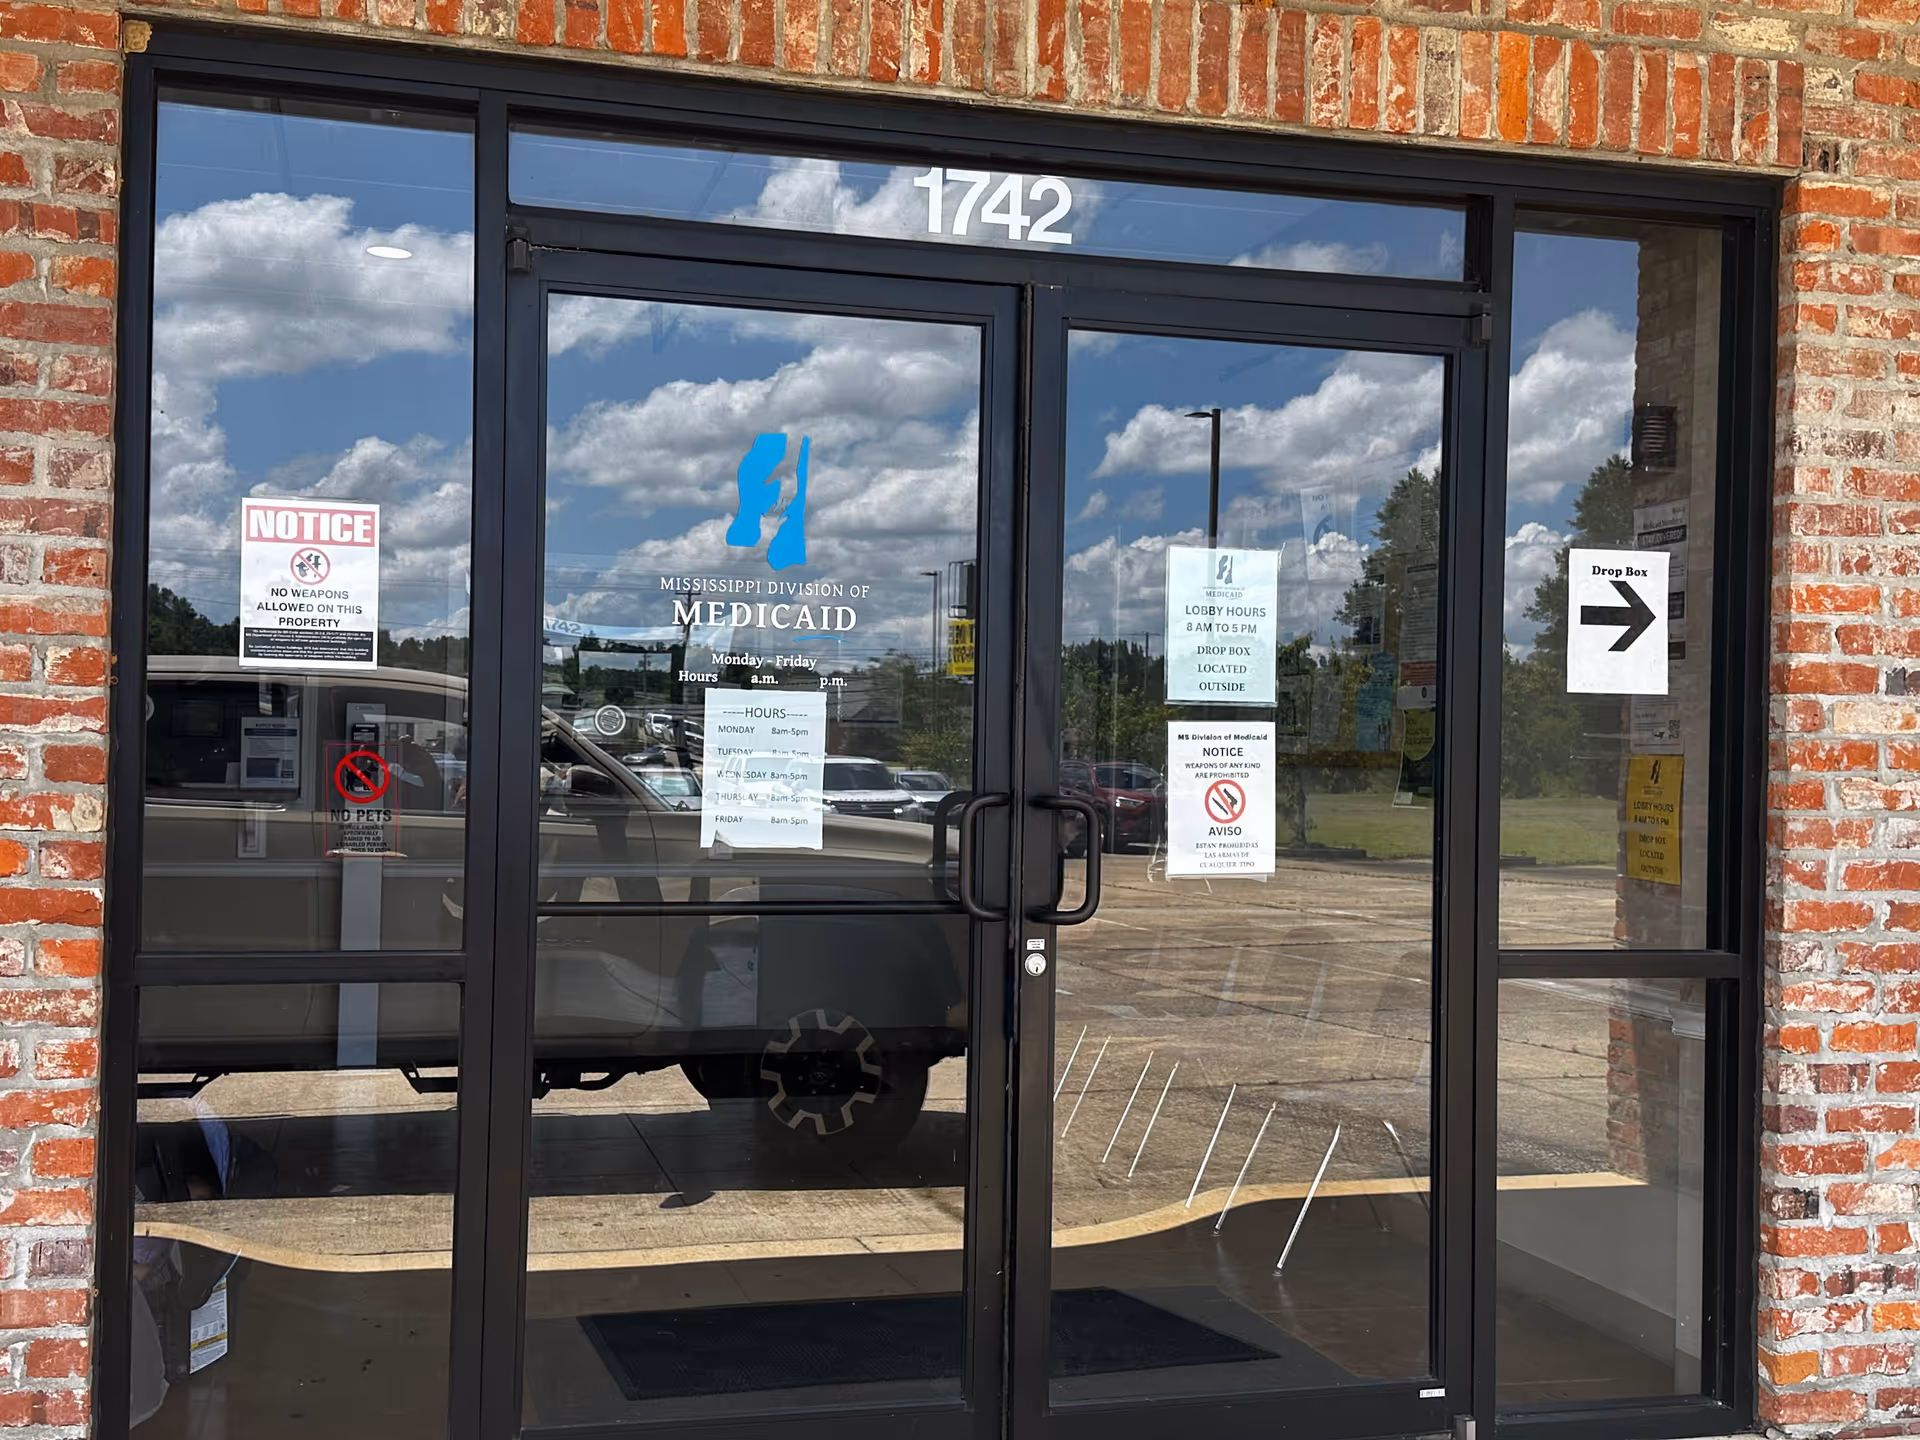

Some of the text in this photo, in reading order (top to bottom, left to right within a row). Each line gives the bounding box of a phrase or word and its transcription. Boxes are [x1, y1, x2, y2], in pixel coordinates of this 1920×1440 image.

[913, 166, 1073, 245] 1742
[249, 508, 372, 543] NOTICE
[1592, 565, 1648, 578] Drop Box
[660, 576, 870, 598] MISSISSIPPI DIVISION OF
[271, 588, 349, 599] NO WEAPONS
[1205, 590, 1243, 599] MEDICAID
[257, 602, 362, 614] ALLOWED ON THIS
[1186, 605, 1266, 618] LOBBY HOURS
[671, 600, 857, 631] MEDICAID
[279, 617, 340, 628] PROPERTY
[1186, 622, 1257, 634] 8 AM TO 5 PM
[1197, 645, 1251, 656] DROP BOX
[711, 653, 764, 669] Monday
[775, 655, 817, 671] Friday
[1197, 664, 1247, 674] LOCATED
[678, 671, 848, 689] Hours a.m. p.m.
[1199, 681, 1246, 692] OUTSIDE
[718, 725, 808, 737] MONDAY 8am-5pm
[1191, 733, 1222, 741] Division
[1223, 733, 1232, 741] of
[1233, 733, 1268, 741] Medicaid
[1202, 747, 1244, 757] NOTICE
[770, 771, 808, 781] 8am-5pm
[770, 793, 808, 803] 8am-5pm
[330, 809, 392, 822] NO PETS
[715, 814, 808, 826] FRIDAY 8am-5pm
[1208, 826, 1242, 836] AVISO
